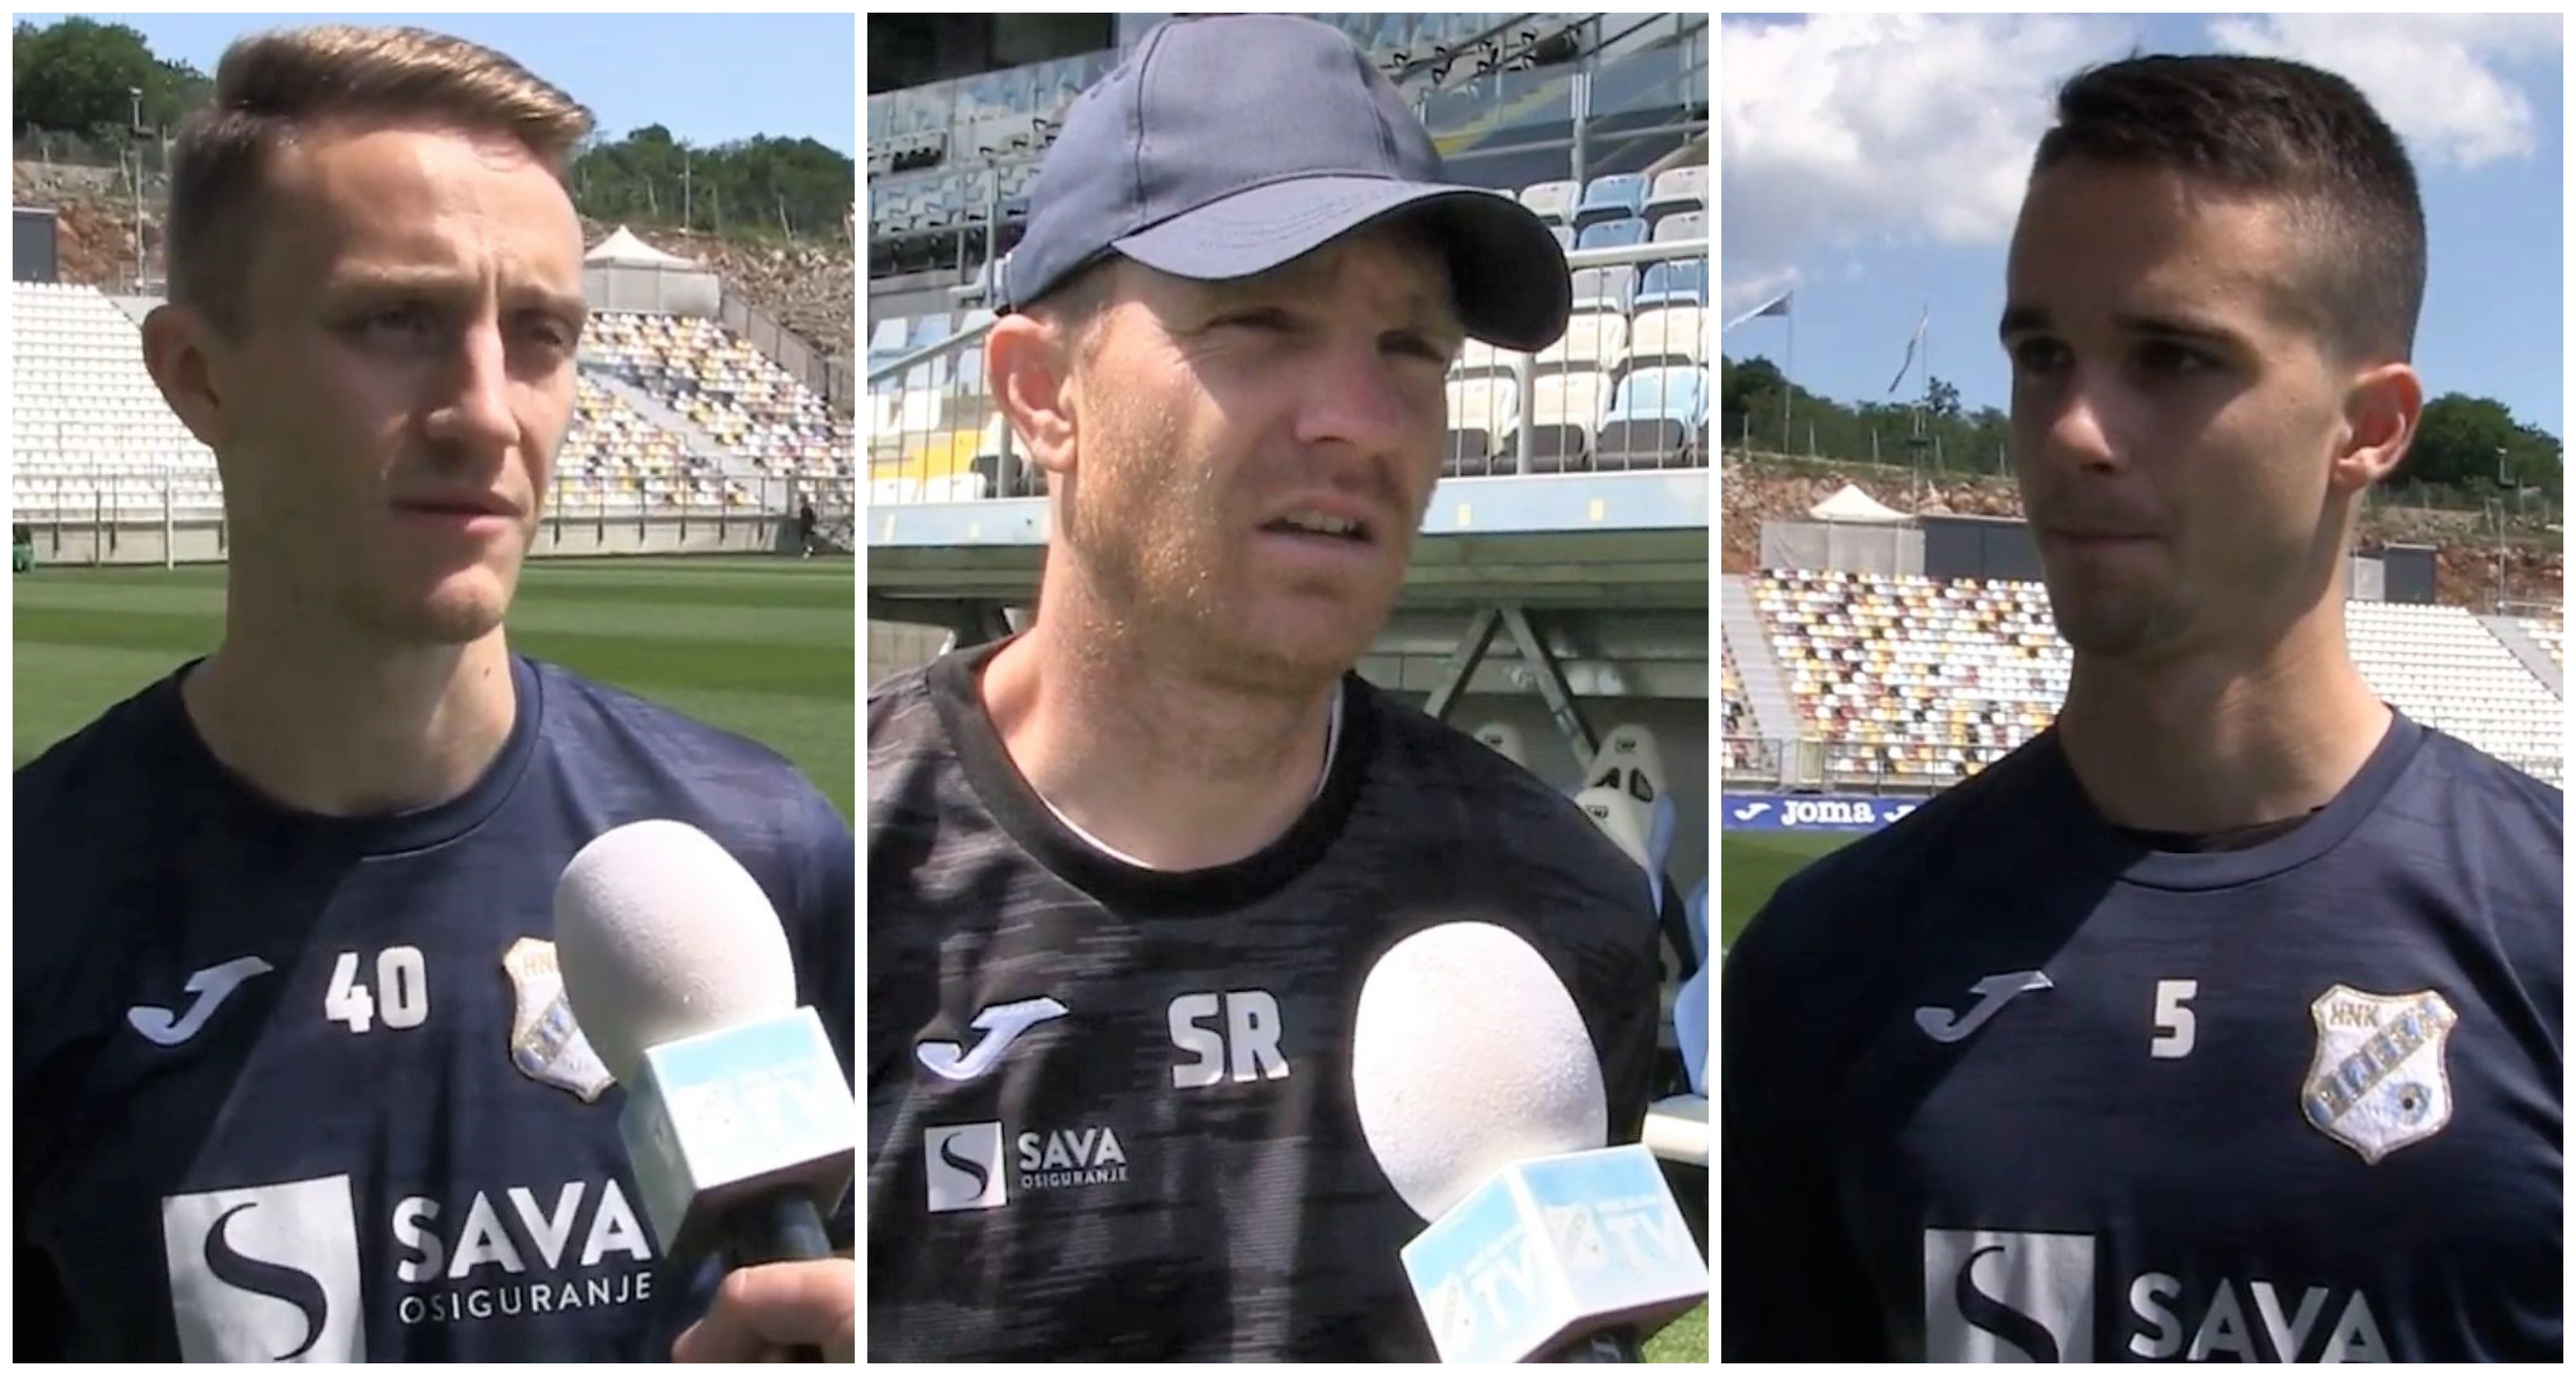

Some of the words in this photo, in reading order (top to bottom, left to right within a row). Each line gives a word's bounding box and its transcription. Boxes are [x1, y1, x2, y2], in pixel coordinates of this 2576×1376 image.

[324, 945, 429, 1034] 40
[2151, 979, 2198, 1058] 5
[1168, 991, 1290, 1088] SR
[1017, 1127, 1126, 1171] SAVA
[1020, 1166, 1127, 1189] OSIGURANJE
[391, 1178, 653, 1284] SAVA
[399, 1271, 652, 1324] OSIGURANJE
[2129, 1273, 2391, 1363] SAVA
